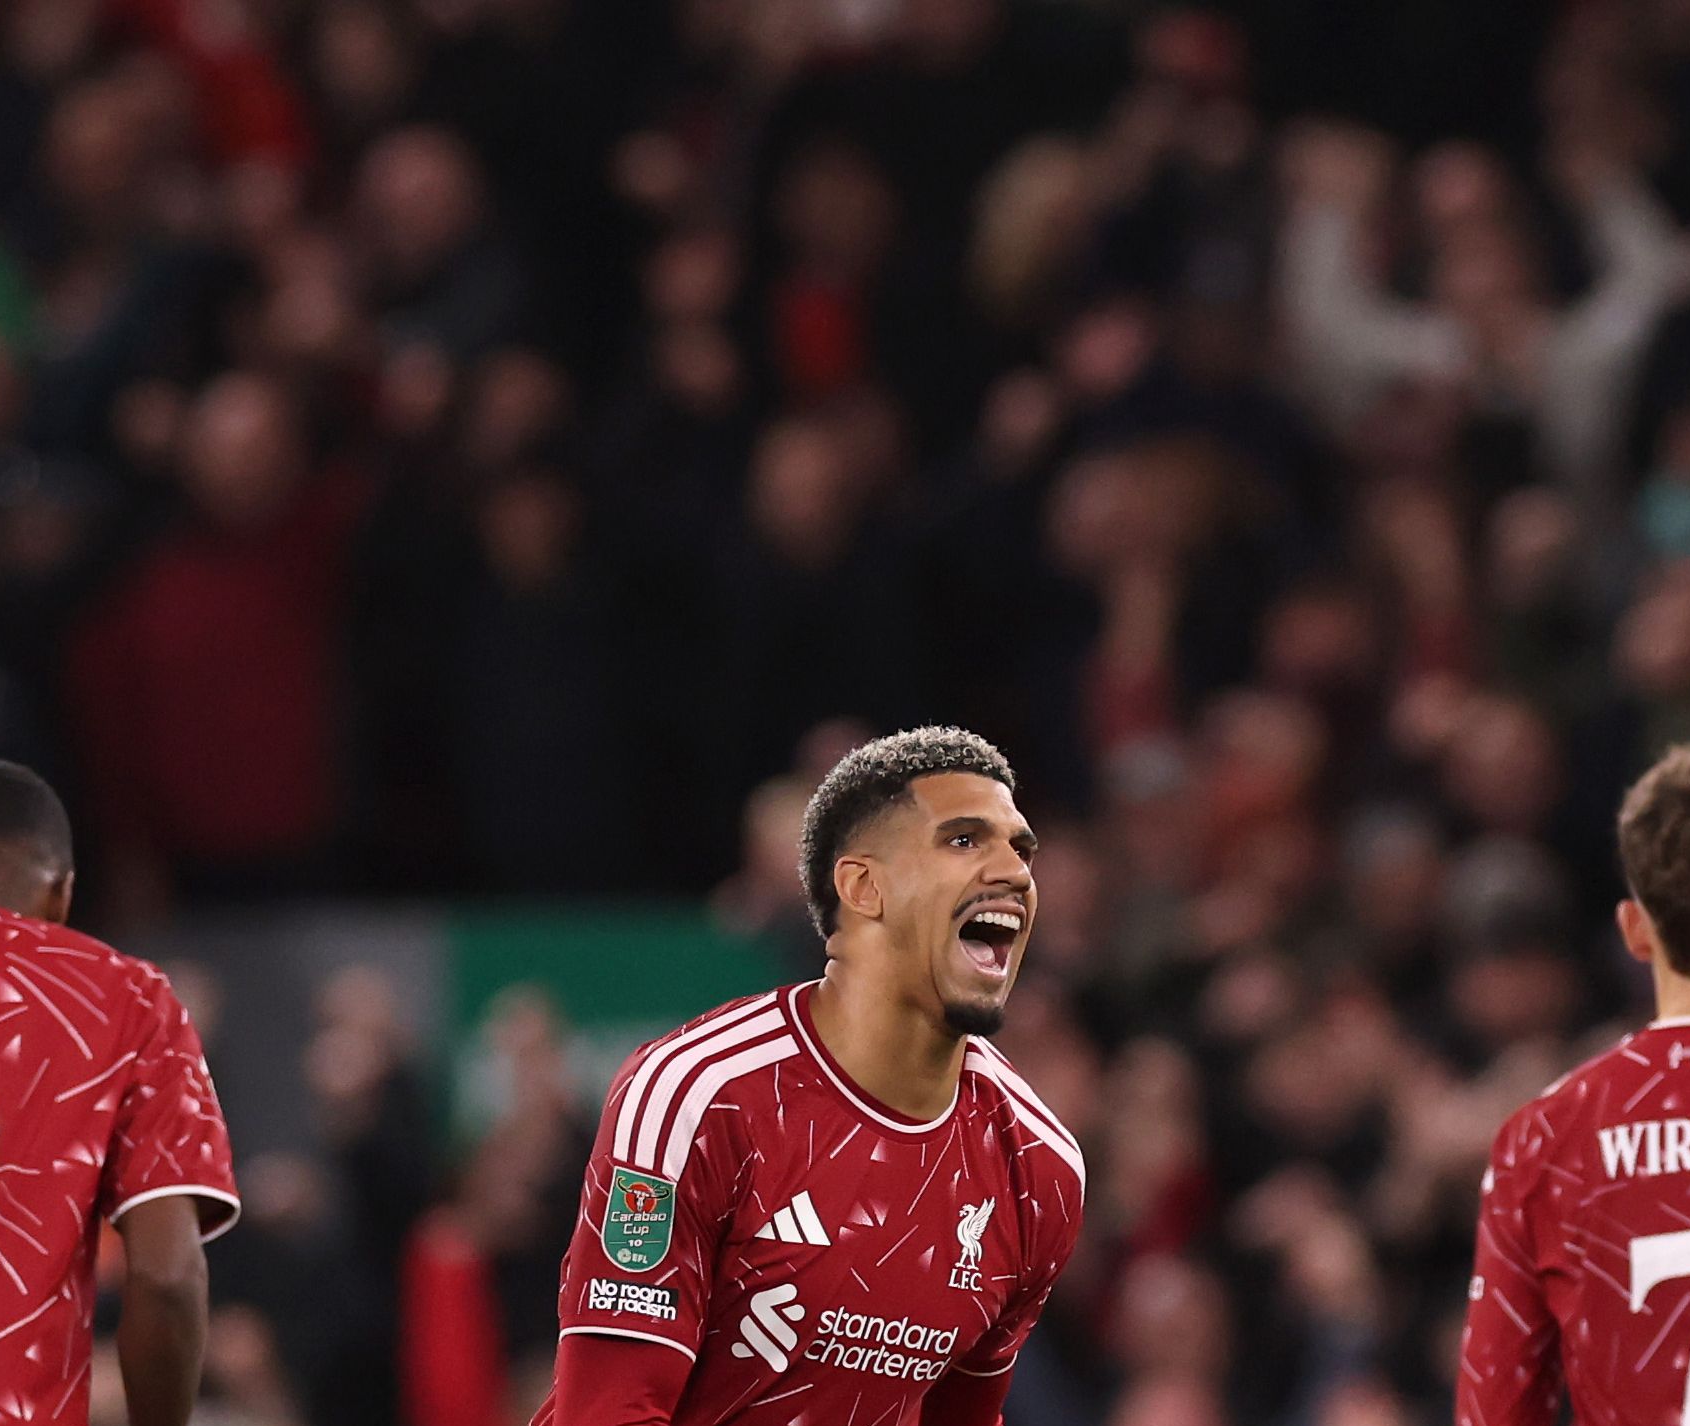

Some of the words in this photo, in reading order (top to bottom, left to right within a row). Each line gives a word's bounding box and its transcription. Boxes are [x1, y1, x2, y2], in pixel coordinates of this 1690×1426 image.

[610, 1211, 667, 1222] Carabao
[623, 1223, 650, 1236] Cup
[631, 1253, 648, 1265] EFL
[590, 1278, 618, 1297] No
[620, 1283, 670, 1304] room
[588, 1293, 616, 1310] for
[617, 1299, 677, 1321] racism
[816, 1305, 959, 1355] standard
[803, 1337, 952, 1382] chartered
